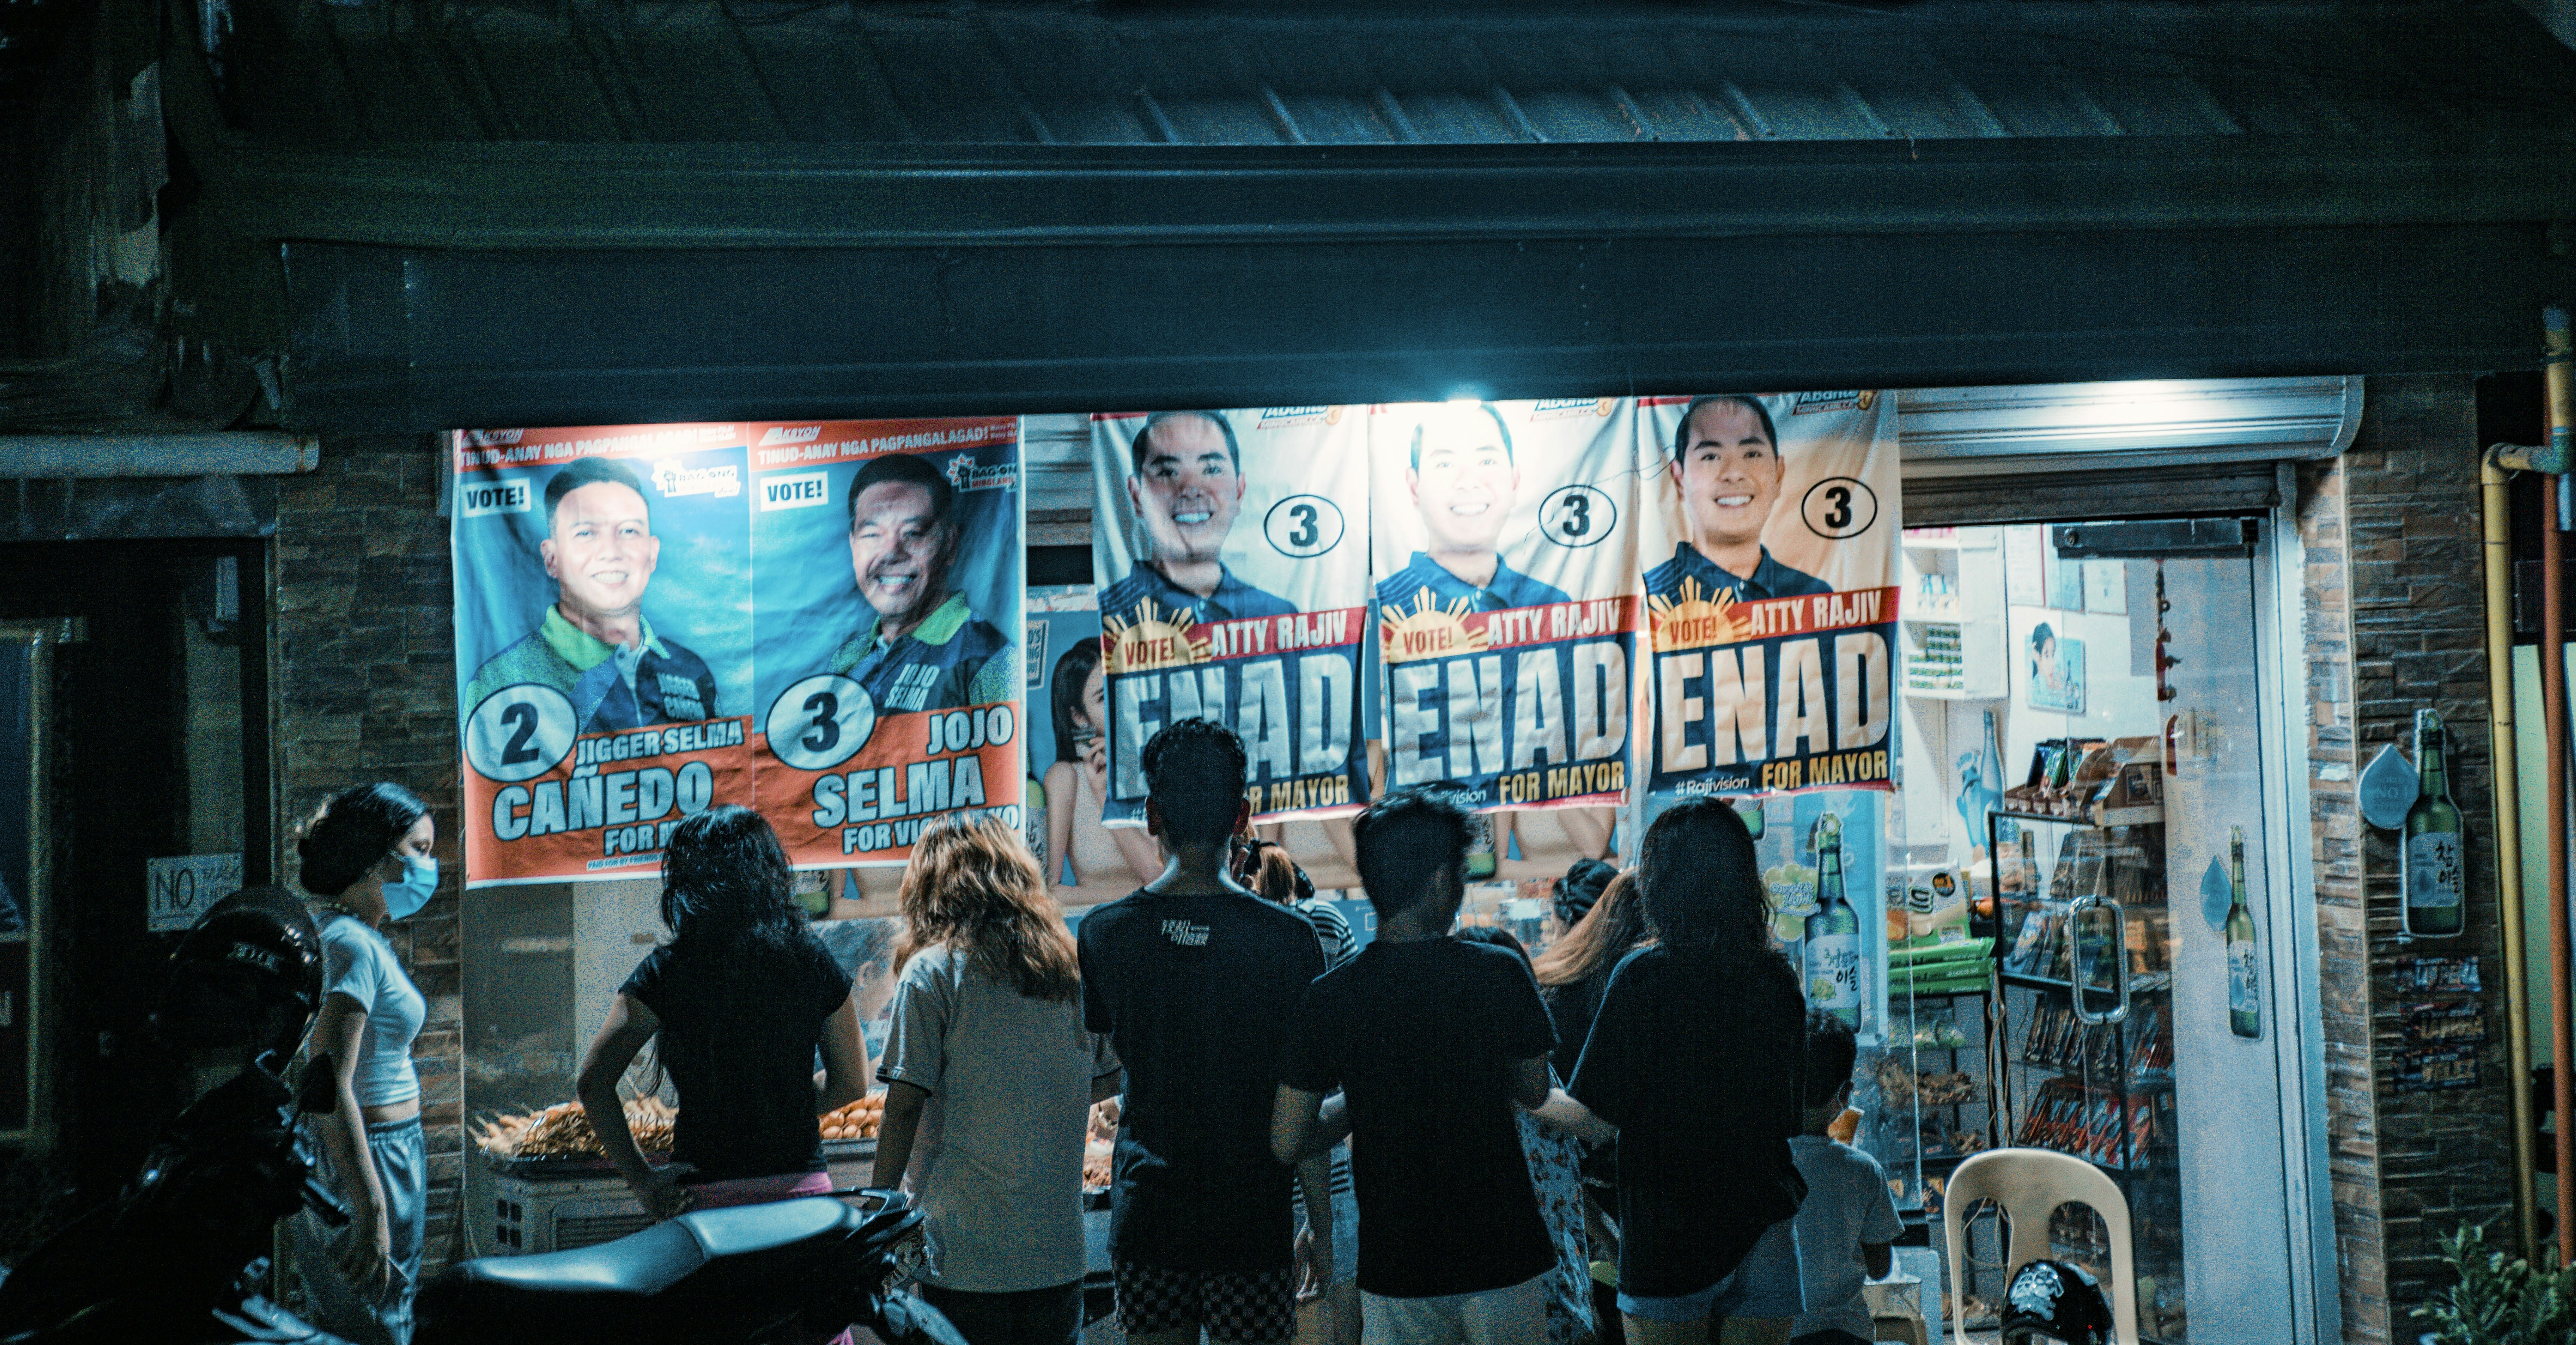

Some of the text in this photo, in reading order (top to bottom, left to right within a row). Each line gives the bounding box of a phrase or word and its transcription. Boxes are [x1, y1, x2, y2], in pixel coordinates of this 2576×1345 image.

[544, 441, 574, 459] NGA
[757, 442, 838, 465] TINUD-ANAY
[840, 439, 869, 457] NGA
[467, 486, 524, 510] VOTE!
[767, 480, 822, 502] VOTE!
[1825, 486, 1852, 528] 3
[1290, 504, 1318, 547] 3
[1563, 494, 1590, 537] 3
[1211, 610, 1347, 658] ATTY RAJIV
[1488, 599, 1621, 647] ATTY RAJIV
[1669, 614, 1718, 645] VOTE!
[1751, 590, 1882, 637] ATTY RAJIV
[1124, 637, 1175, 666] VOTE!
[1403, 626, 1452, 656] VOTE!
[895, 663, 940, 688] JOJO
[884, 685, 930, 712] SELMA
[1393, 641, 1627, 786] ENAD
[1660, 631, 1890, 773] ENAD
[500, 702, 539, 766] 2
[575, 720, 744, 766] JIGGER SELMA
[802, 692, 840, 753] 3
[927, 705, 1015, 756] JOJO
[813, 754, 987, 829] SELMA
[1499, 761, 1625, 806] FOR MAYOR
[1675, 775, 1750, 797] #Rajivision
[1762, 750, 1888, 792] FOR MAYOR
[492, 761, 714, 841] CAÑEDO
[1270, 775, 1349, 813] MAYOR
[604, 823, 656, 856] FOR
[843, 822, 893, 855] FOR
[893, 816, 934, 847] VIC
[155, 868, 194, 910] NO
